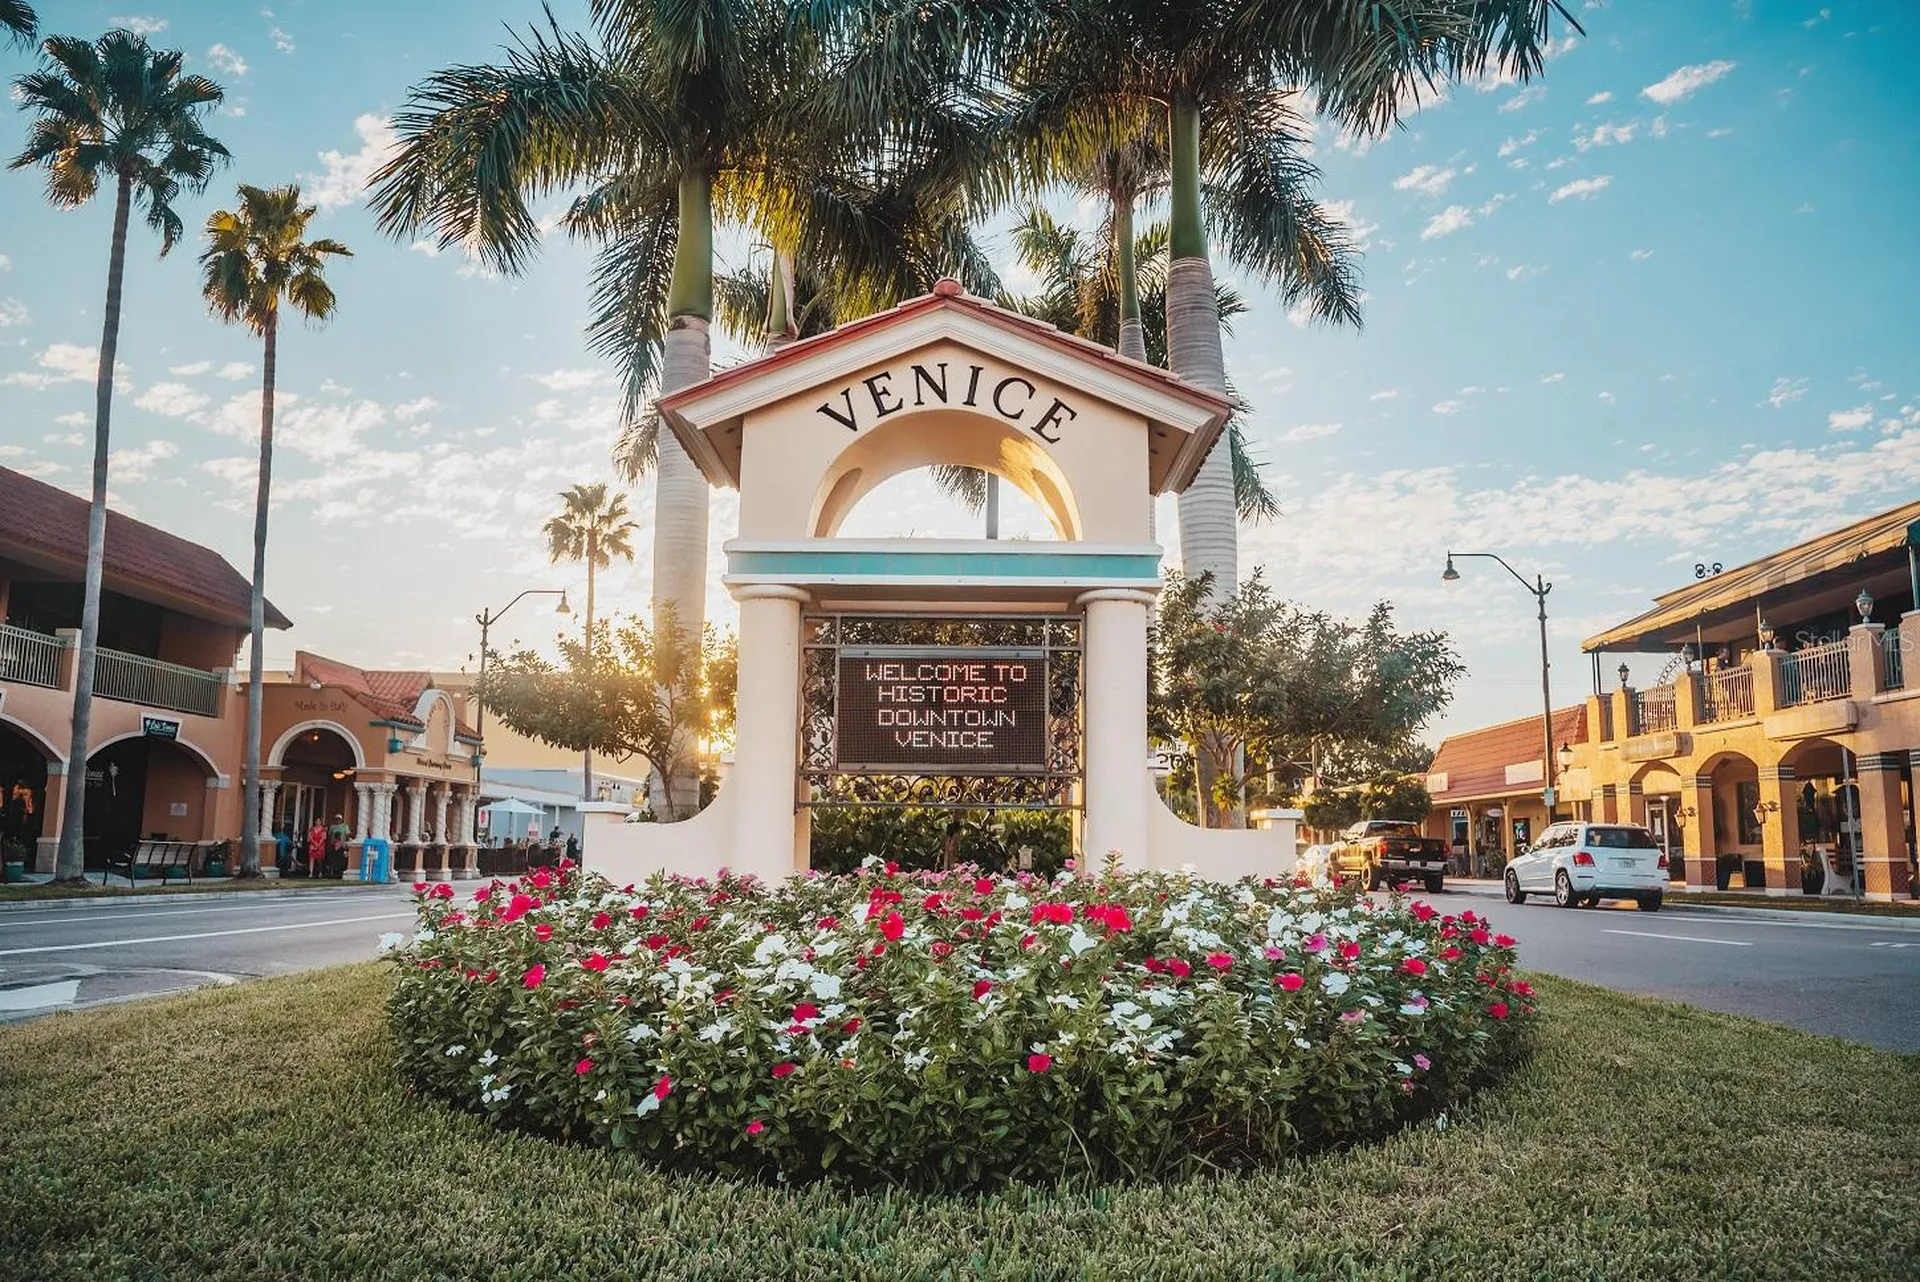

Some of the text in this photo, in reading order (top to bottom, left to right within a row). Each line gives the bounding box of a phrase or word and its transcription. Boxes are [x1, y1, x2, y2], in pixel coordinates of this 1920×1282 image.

[817, 363, 1077, 444] VENICE
[866, 664, 1027, 682] WELCOME TO
[878, 686, 1007, 703] HISTORIC
[878, 709, 1016, 726] DOWNTOWN
[895, 731, 994, 748] VENICE
